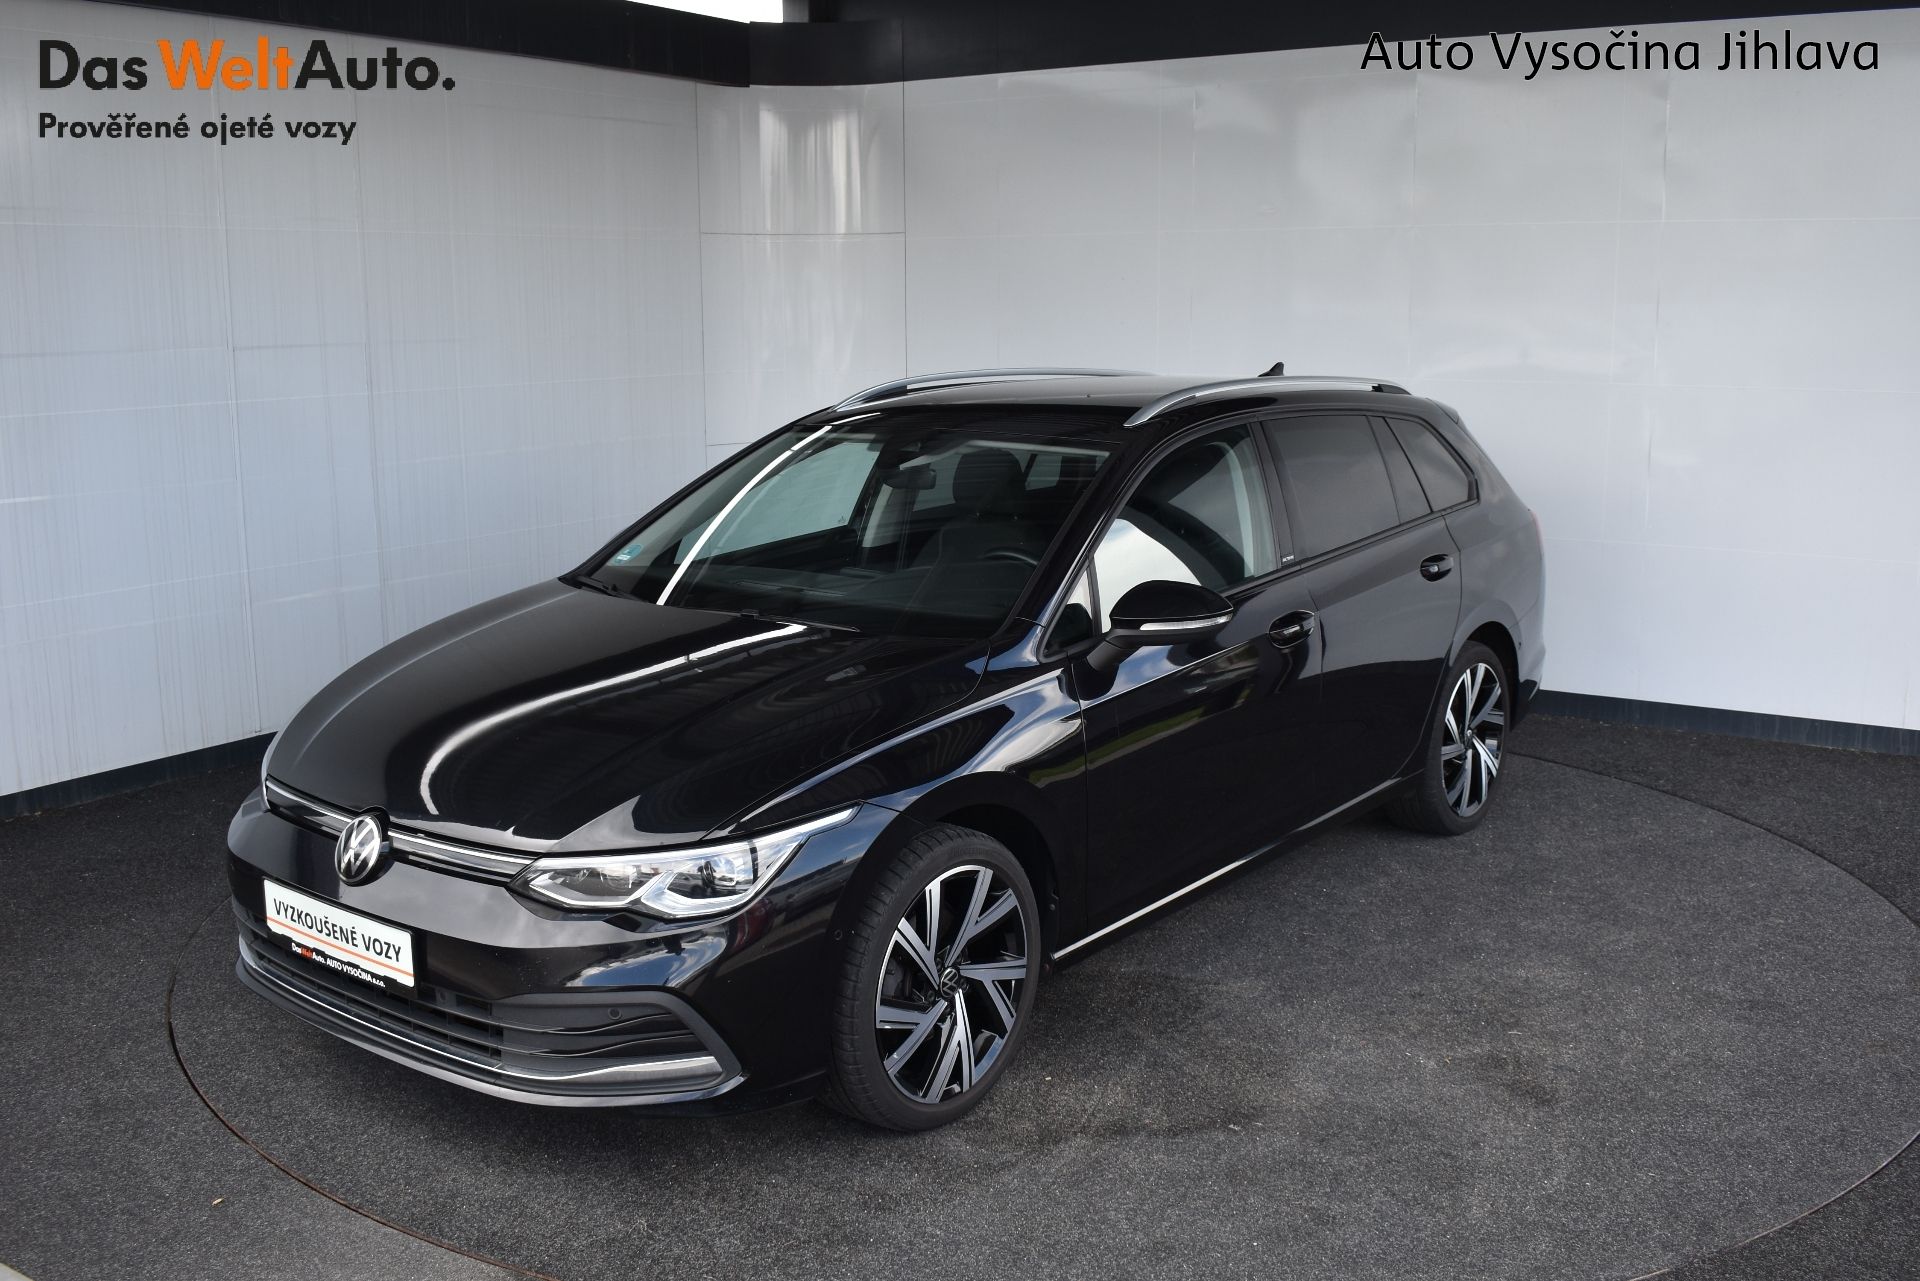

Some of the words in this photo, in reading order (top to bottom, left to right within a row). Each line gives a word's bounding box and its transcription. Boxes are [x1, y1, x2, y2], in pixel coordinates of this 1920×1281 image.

[273, 898, 359, 948] VYZKOUŠENÉ
[362, 933, 402, 963] VOZY
[326, 958, 342, 970] AUTO
[342, 963, 372, 983] VYSOČINA
